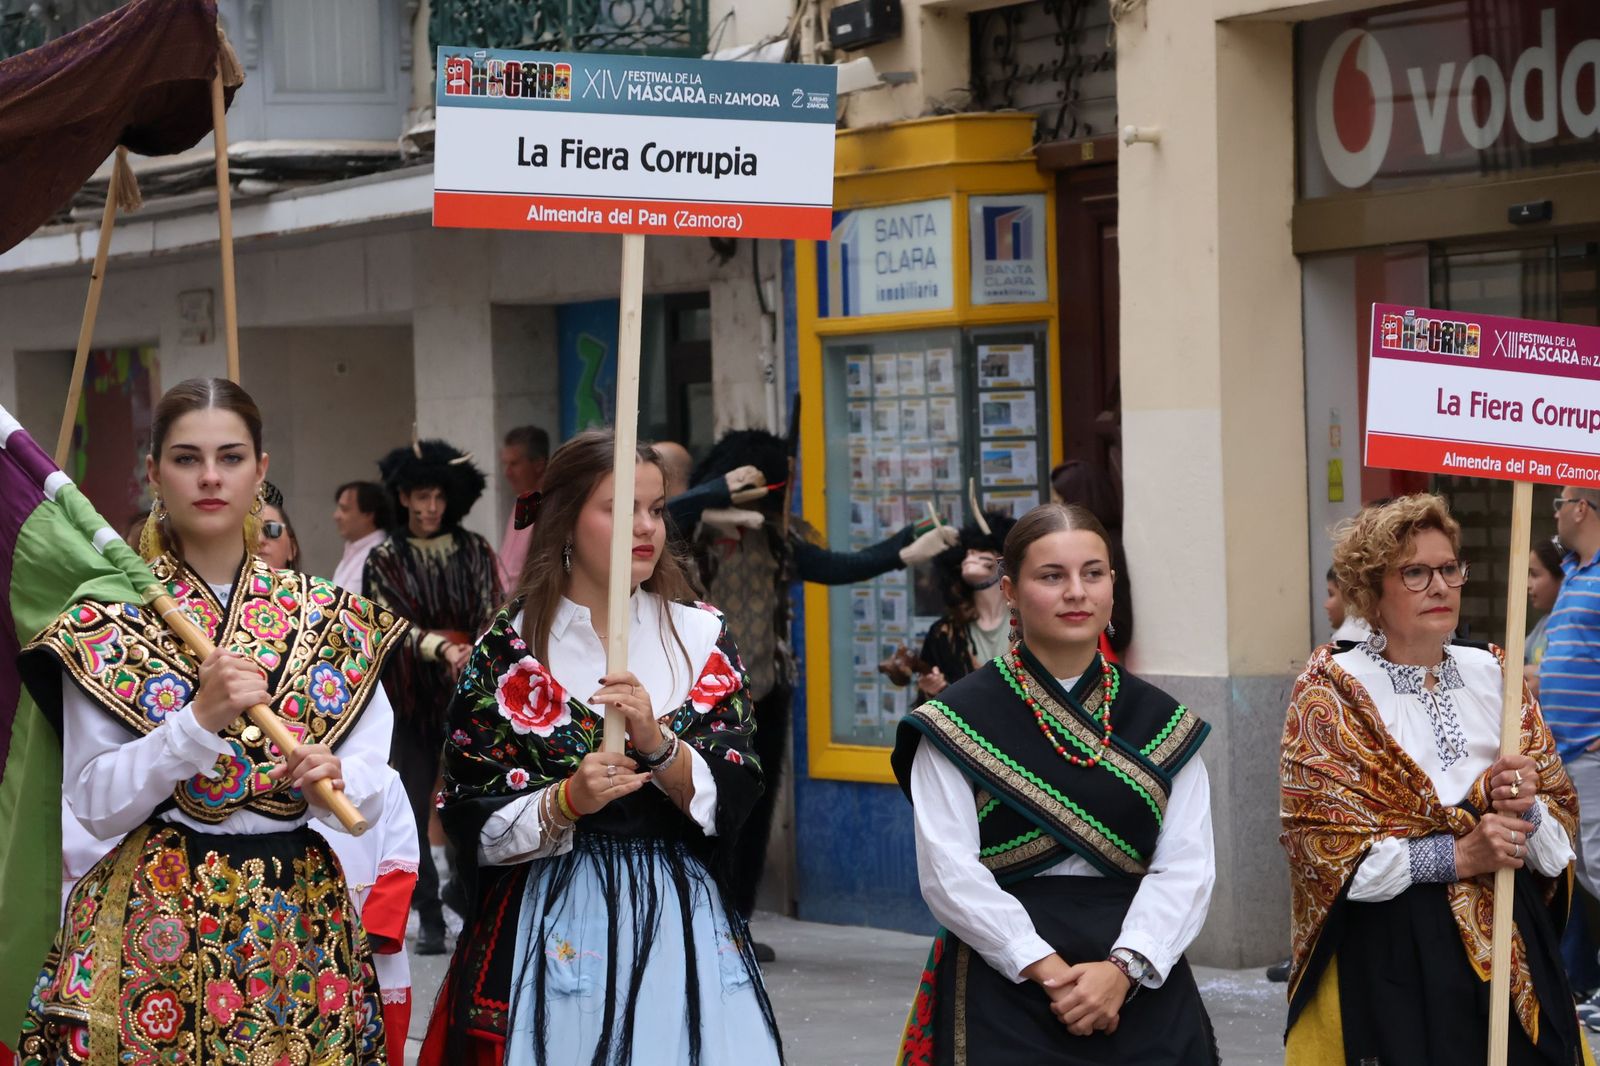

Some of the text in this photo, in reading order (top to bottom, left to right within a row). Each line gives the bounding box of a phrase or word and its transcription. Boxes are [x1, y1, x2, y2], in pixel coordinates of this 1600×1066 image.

[582, 68, 628, 100] XIV
[628, 71, 702, 85] FESTIVAL DE LA
[1407, 8, 1600, 155] voda
[628, 82, 780, 107] MÁSCARA EN ZAMORA
[518, 136, 757, 179] La Fiera Corrupia
[526, 205, 743, 231] Almendra del Pan (Zamora)
[875, 213, 937, 243] SANTA
[875, 247, 937, 276] CLARA
[984, 264, 1034, 275] SANTA
[876, 281, 939, 302] inmobiliaria
[984, 276, 1035, 287] CLARA
[1492, 329, 1518, 358] XIII
[1519, 332, 1576, 348] FESTIVAL DE LA
[1518, 342, 1600, 367] MÁSCARA EN Z
[1437, 387, 1600, 434] La Fiera Corrup
[1442, 452, 1501, 471] Almendra
[1506, 458, 1525, 473] del
[1529, 460, 1551, 476] Pan
